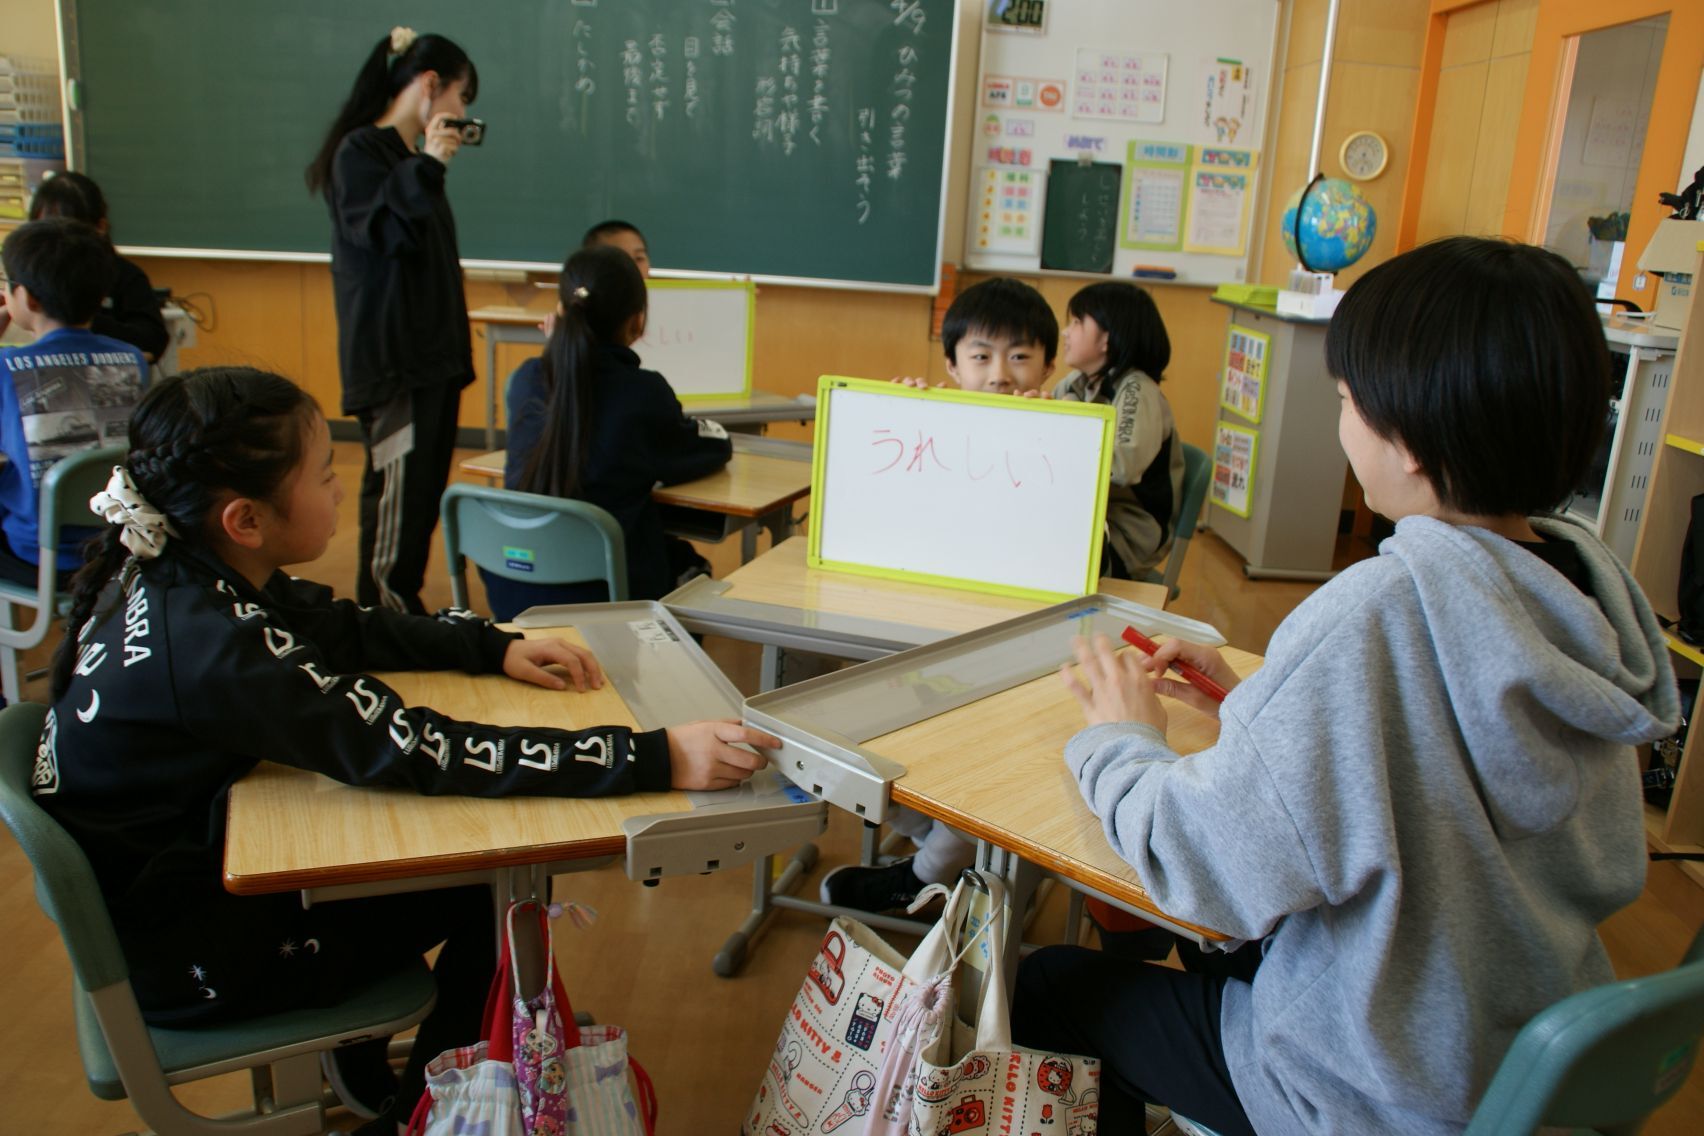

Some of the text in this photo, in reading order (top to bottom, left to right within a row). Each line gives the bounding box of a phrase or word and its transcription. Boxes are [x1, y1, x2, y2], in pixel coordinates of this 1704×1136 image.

[710, 8, 738, 56] 会話
[775, 25, 802, 158] 気持ちや様子
[805, 18, 833, 147] 言葉を書く
[886, 45, 918, 181] ひみつの言葉
[855, 106, 876, 225] 引き出そう
[4, 355, 34, 372] LOS
[35, 352, 89, 370] ANGELES
[870, 427, 1056, 489] うれしい
[123, 573, 153, 668] MBRA
[800, 1018, 831, 1055] KITTY
[795, 1072, 824, 1096] HANGER
[998, 1095, 1016, 1136] KITT
